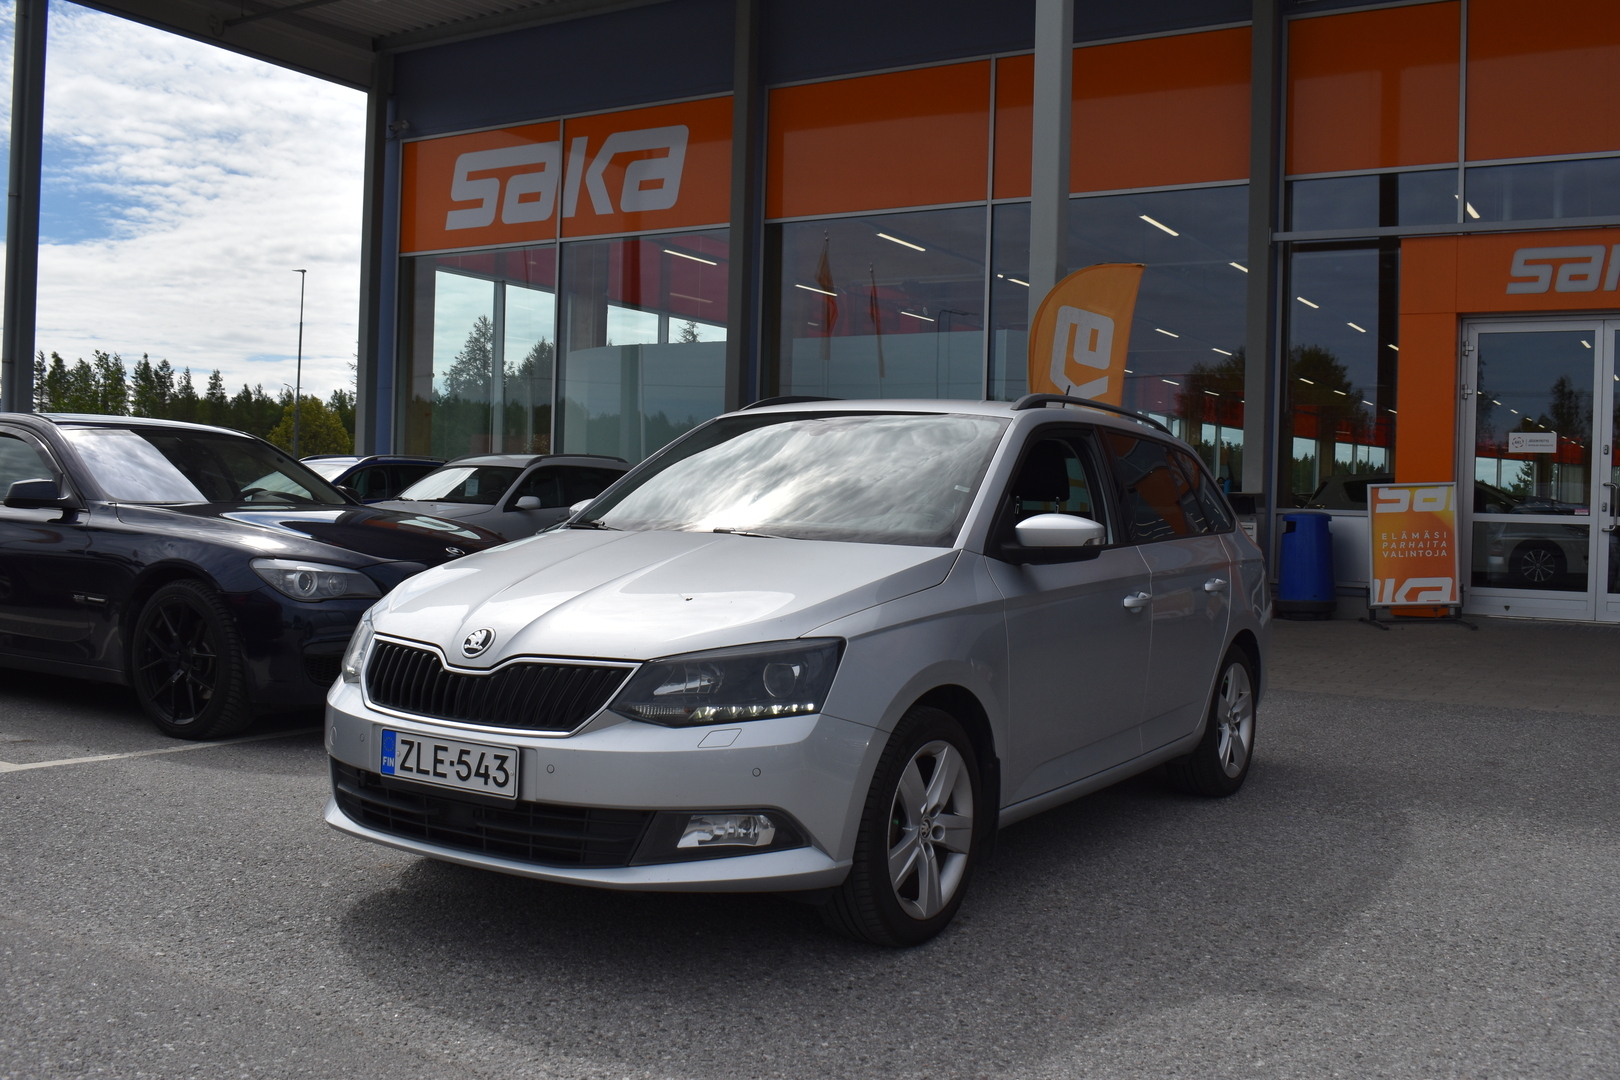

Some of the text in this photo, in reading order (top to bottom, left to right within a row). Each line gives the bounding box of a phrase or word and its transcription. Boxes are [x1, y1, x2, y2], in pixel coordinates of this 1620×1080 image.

[1381, 530, 1447, 540] ELÄMÄSI
[1382, 541, 1447, 549] PARHAITA
[1382, 550, 1447, 558] VALINTOJA
[382, 756, 395, 768] FIN
[400, 738, 510, 788] ZLE-543
